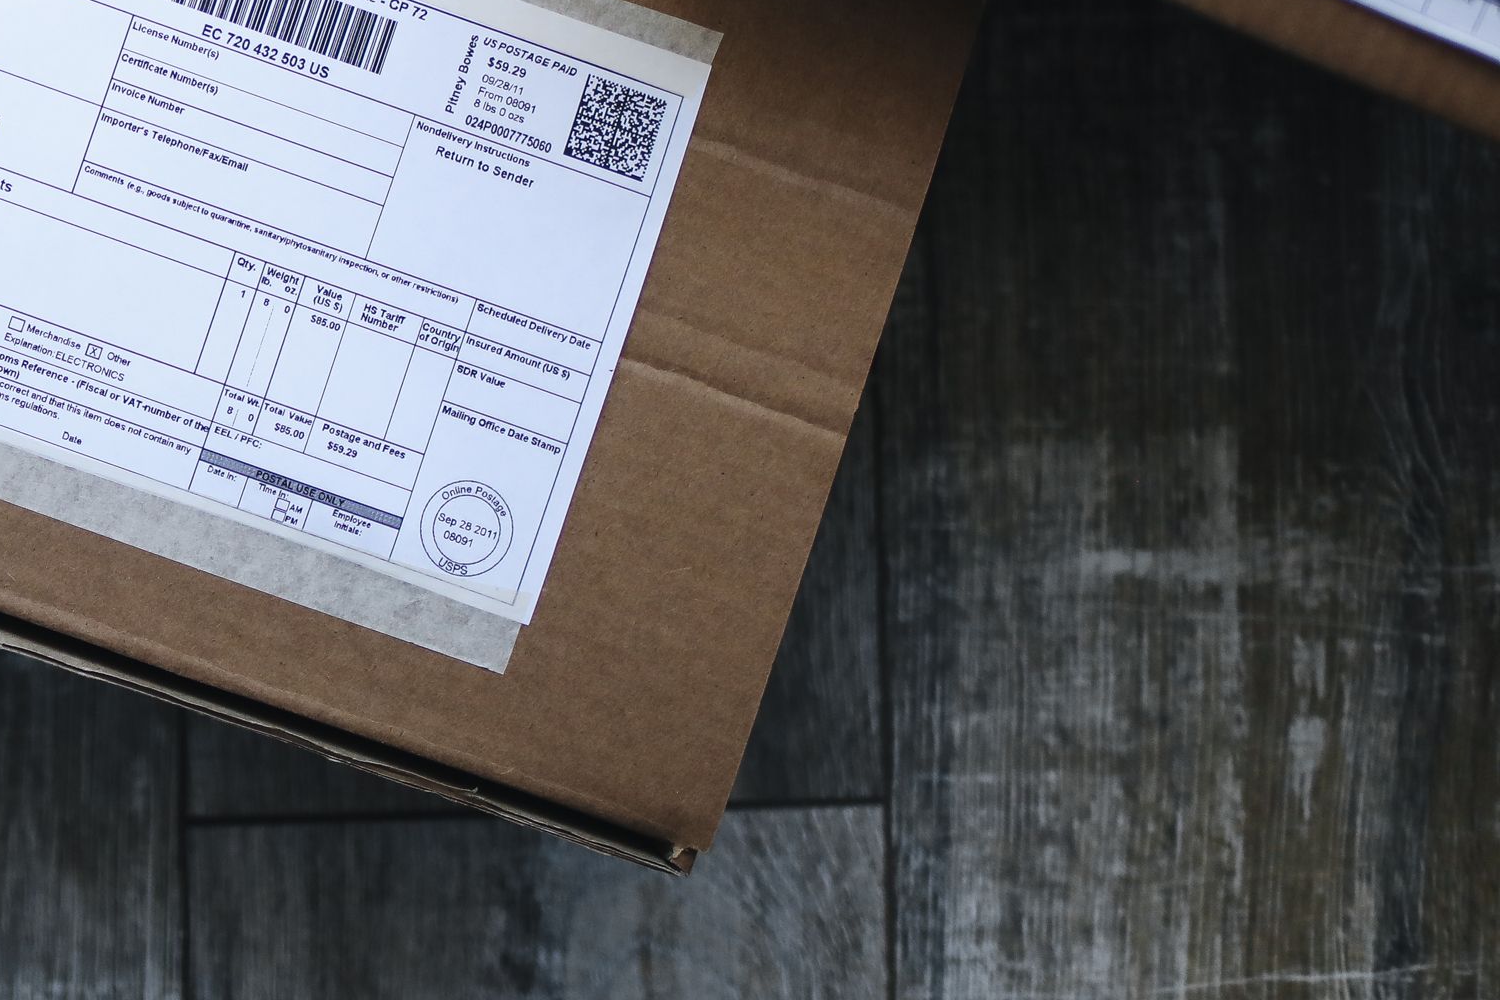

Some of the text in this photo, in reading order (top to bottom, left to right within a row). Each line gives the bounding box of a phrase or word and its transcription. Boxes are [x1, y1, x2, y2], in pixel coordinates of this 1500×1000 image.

[411, 5, 428, 21] 72
[131, 20, 220, 61] License Number(s)
[200, 23, 330, 79] EC 720 432 503 US
[482, 36, 578, 77] US POSTAGE PAID
[486, 56, 527, 78] $59.29
[120, 53, 218, 96] Certificate Number(s)
[445, 34, 479, 114] Pitney Bowes
[481, 73, 524, 95] 09/28/11
[110, 81, 186, 115] Invoice Number
[473, 98, 525, 124] 8 lbs 0 ozs
[477, 85, 536, 114] From 08091
[100, 112, 249, 172] Importer's Telephone/Fax/Email
[415, 120, 531, 167] Nondelivery Instructions
[464, 114, 552, 154] 024P0007775060
[434, 145, 534, 188] Return to Sender
[236, 256, 256, 272] Qty.
[266, 266, 300, 286] Weight
[316, 284, 343, 301] Value
[309, 314, 341, 332] $85.00
[359, 311, 399, 332] Number
[363, 302, 407, 325] HS Tariff
[476, 302, 591, 350] Scheduled Delivery Date
[25, 323, 81, 350] Merchandise
[418, 333, 459, 353] of Origin
[422, 322, 461, 344] Country
[106, 351, 131, 367] Other
[465, 335, 504, 355] Insured
[503, 349, 542, 369] Amount
[456, 364, 506, 388] SDR Value
[10, 396, 60, 420] regulations.
[61, 430, 82, 445] Date
[273, 422, 305, 440] $85.00
[321, 422, 406, 459] Postage and Fees
[441, 404, 561, 455] Mailing Office Date Stamp
[326, 440, 358, 458] $59.29
[255, 469, 347, 507] POSTAL USE ONLY
[441, 486, 507, 517] Online Postage
[437, 512, 497, 540] Sep 28 2011
[442, 529, 473, 548] 08091
[438, 557, 468, 576] USPS
